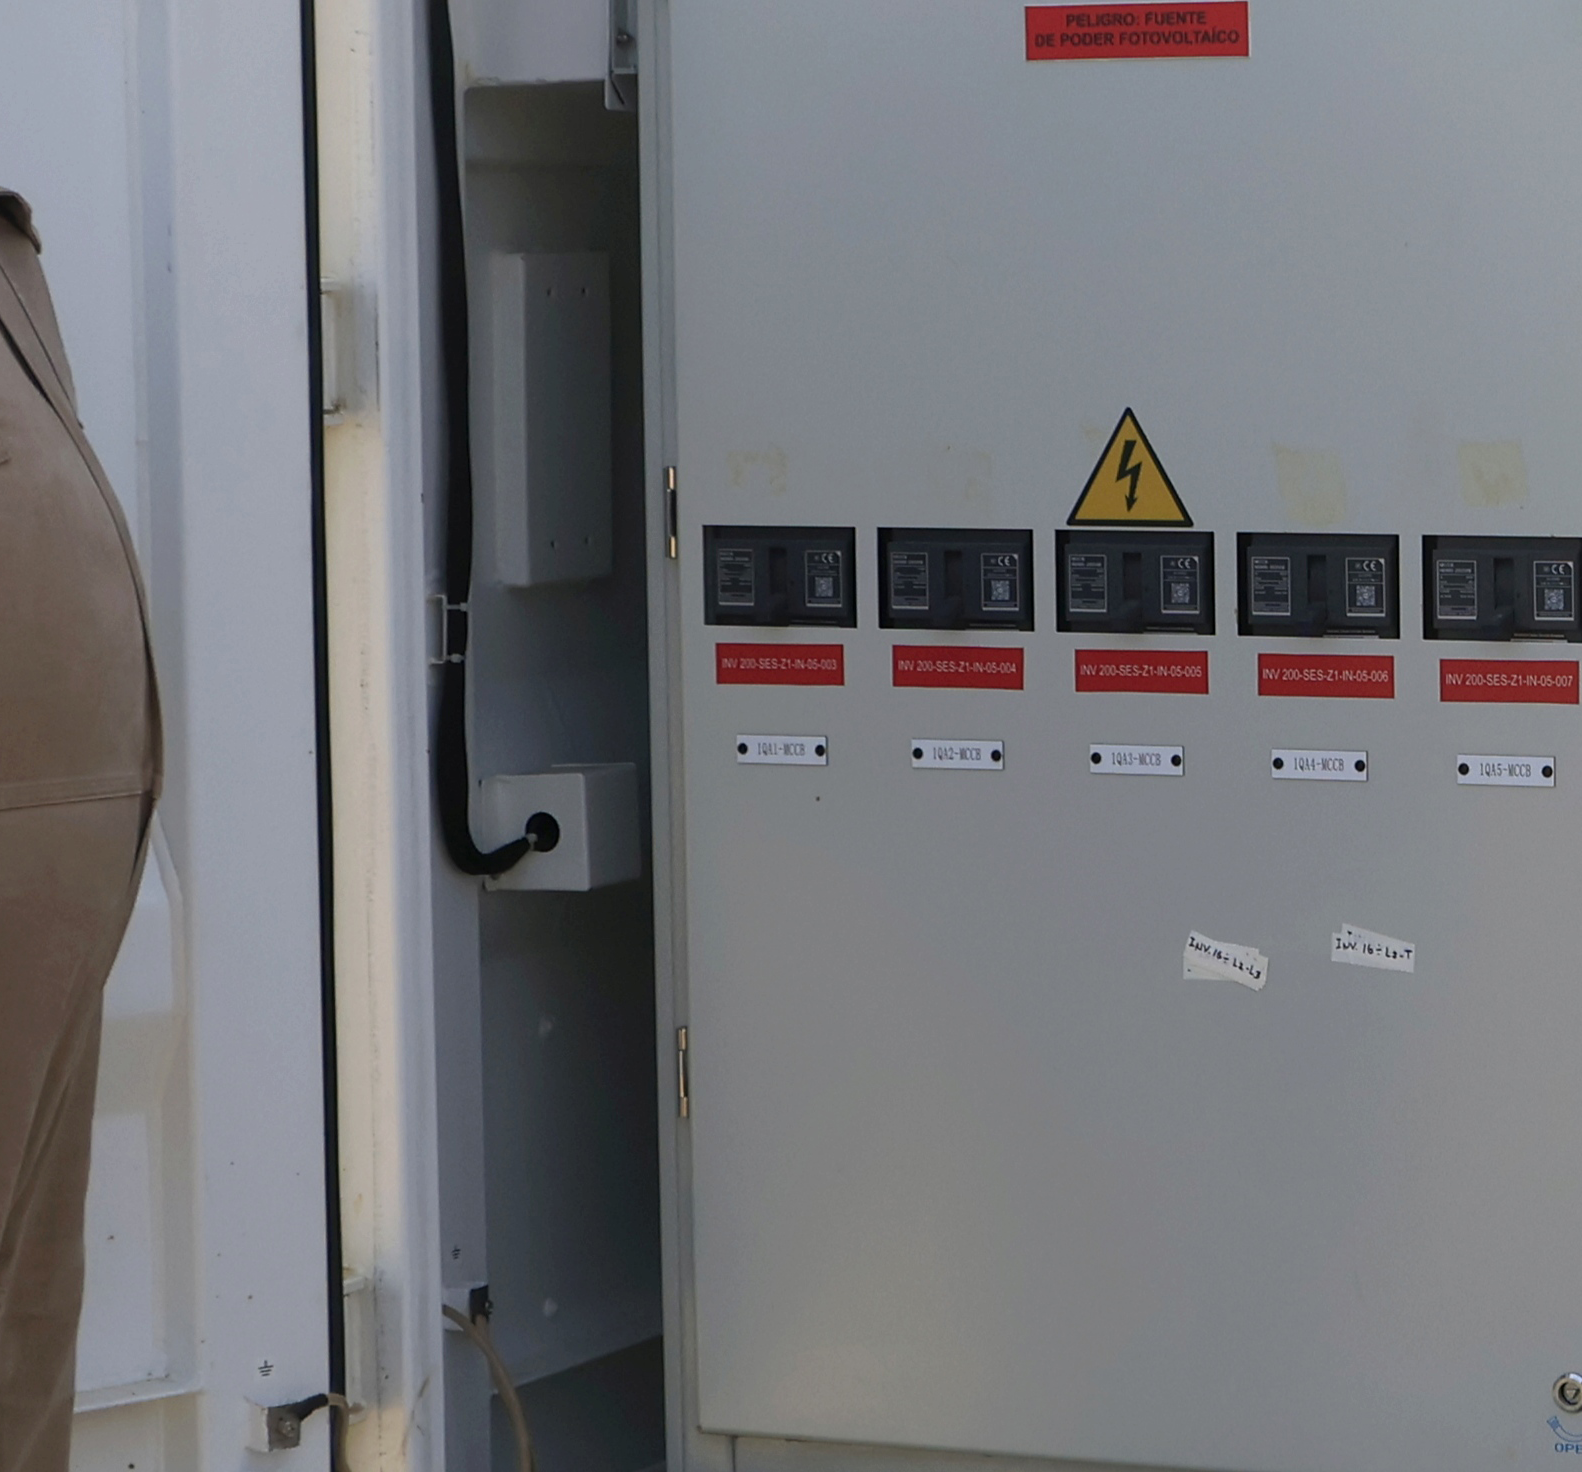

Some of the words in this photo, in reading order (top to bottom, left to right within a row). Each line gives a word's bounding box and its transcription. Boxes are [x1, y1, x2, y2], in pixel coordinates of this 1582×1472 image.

[1066, 13, 1139, 28] PELIGRO:
[1145, 11, 1207, 26] FUENTE
[1035, 33, 1056, 48] DE
[1060, 31, 1114, 47] PODER
[1119, 25, 1240, 46] FOTOVOLTAÍCO
[721, 658, 739, 669] INV
[898, 660, 915, 672] INV
[1080, 664, 1098, 676] INV
[1262, 669, 1281, 681] INV
[1445, 674, 1463, 686] INV
